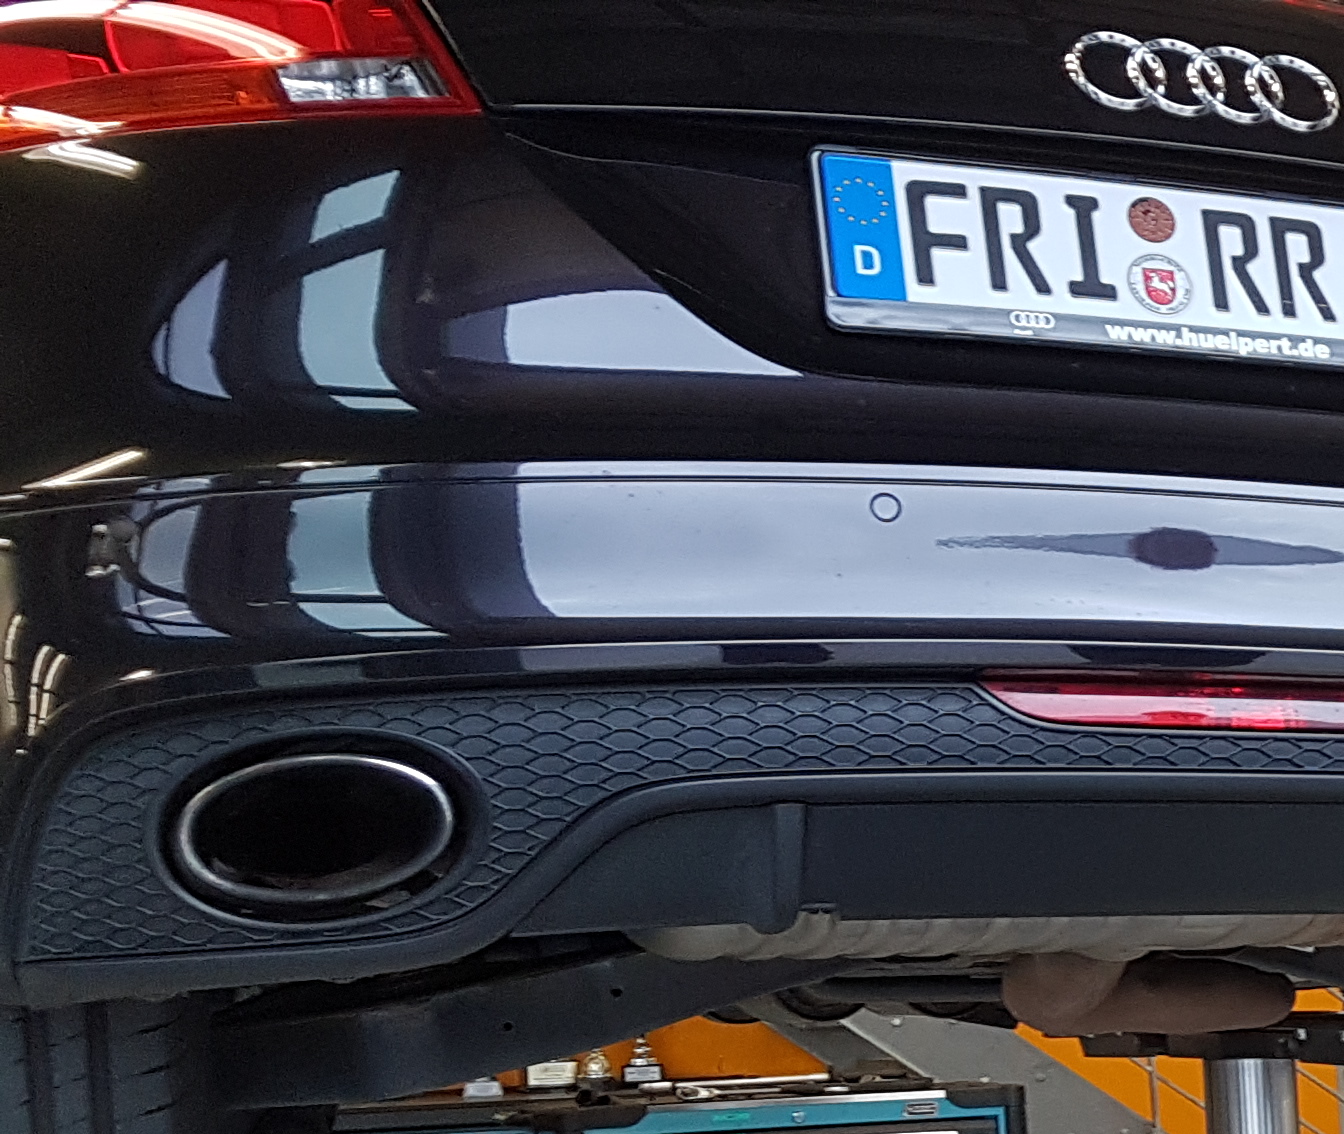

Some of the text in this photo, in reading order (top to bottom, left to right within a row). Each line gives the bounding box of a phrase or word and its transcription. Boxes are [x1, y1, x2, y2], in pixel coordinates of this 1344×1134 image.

[854, 245, 882, 276] D
[905, 180, 1118, 300] FRI
[1201, 208, 1335, 322] RR
[1105, 323, 1331, 358] www.huelpert.de
